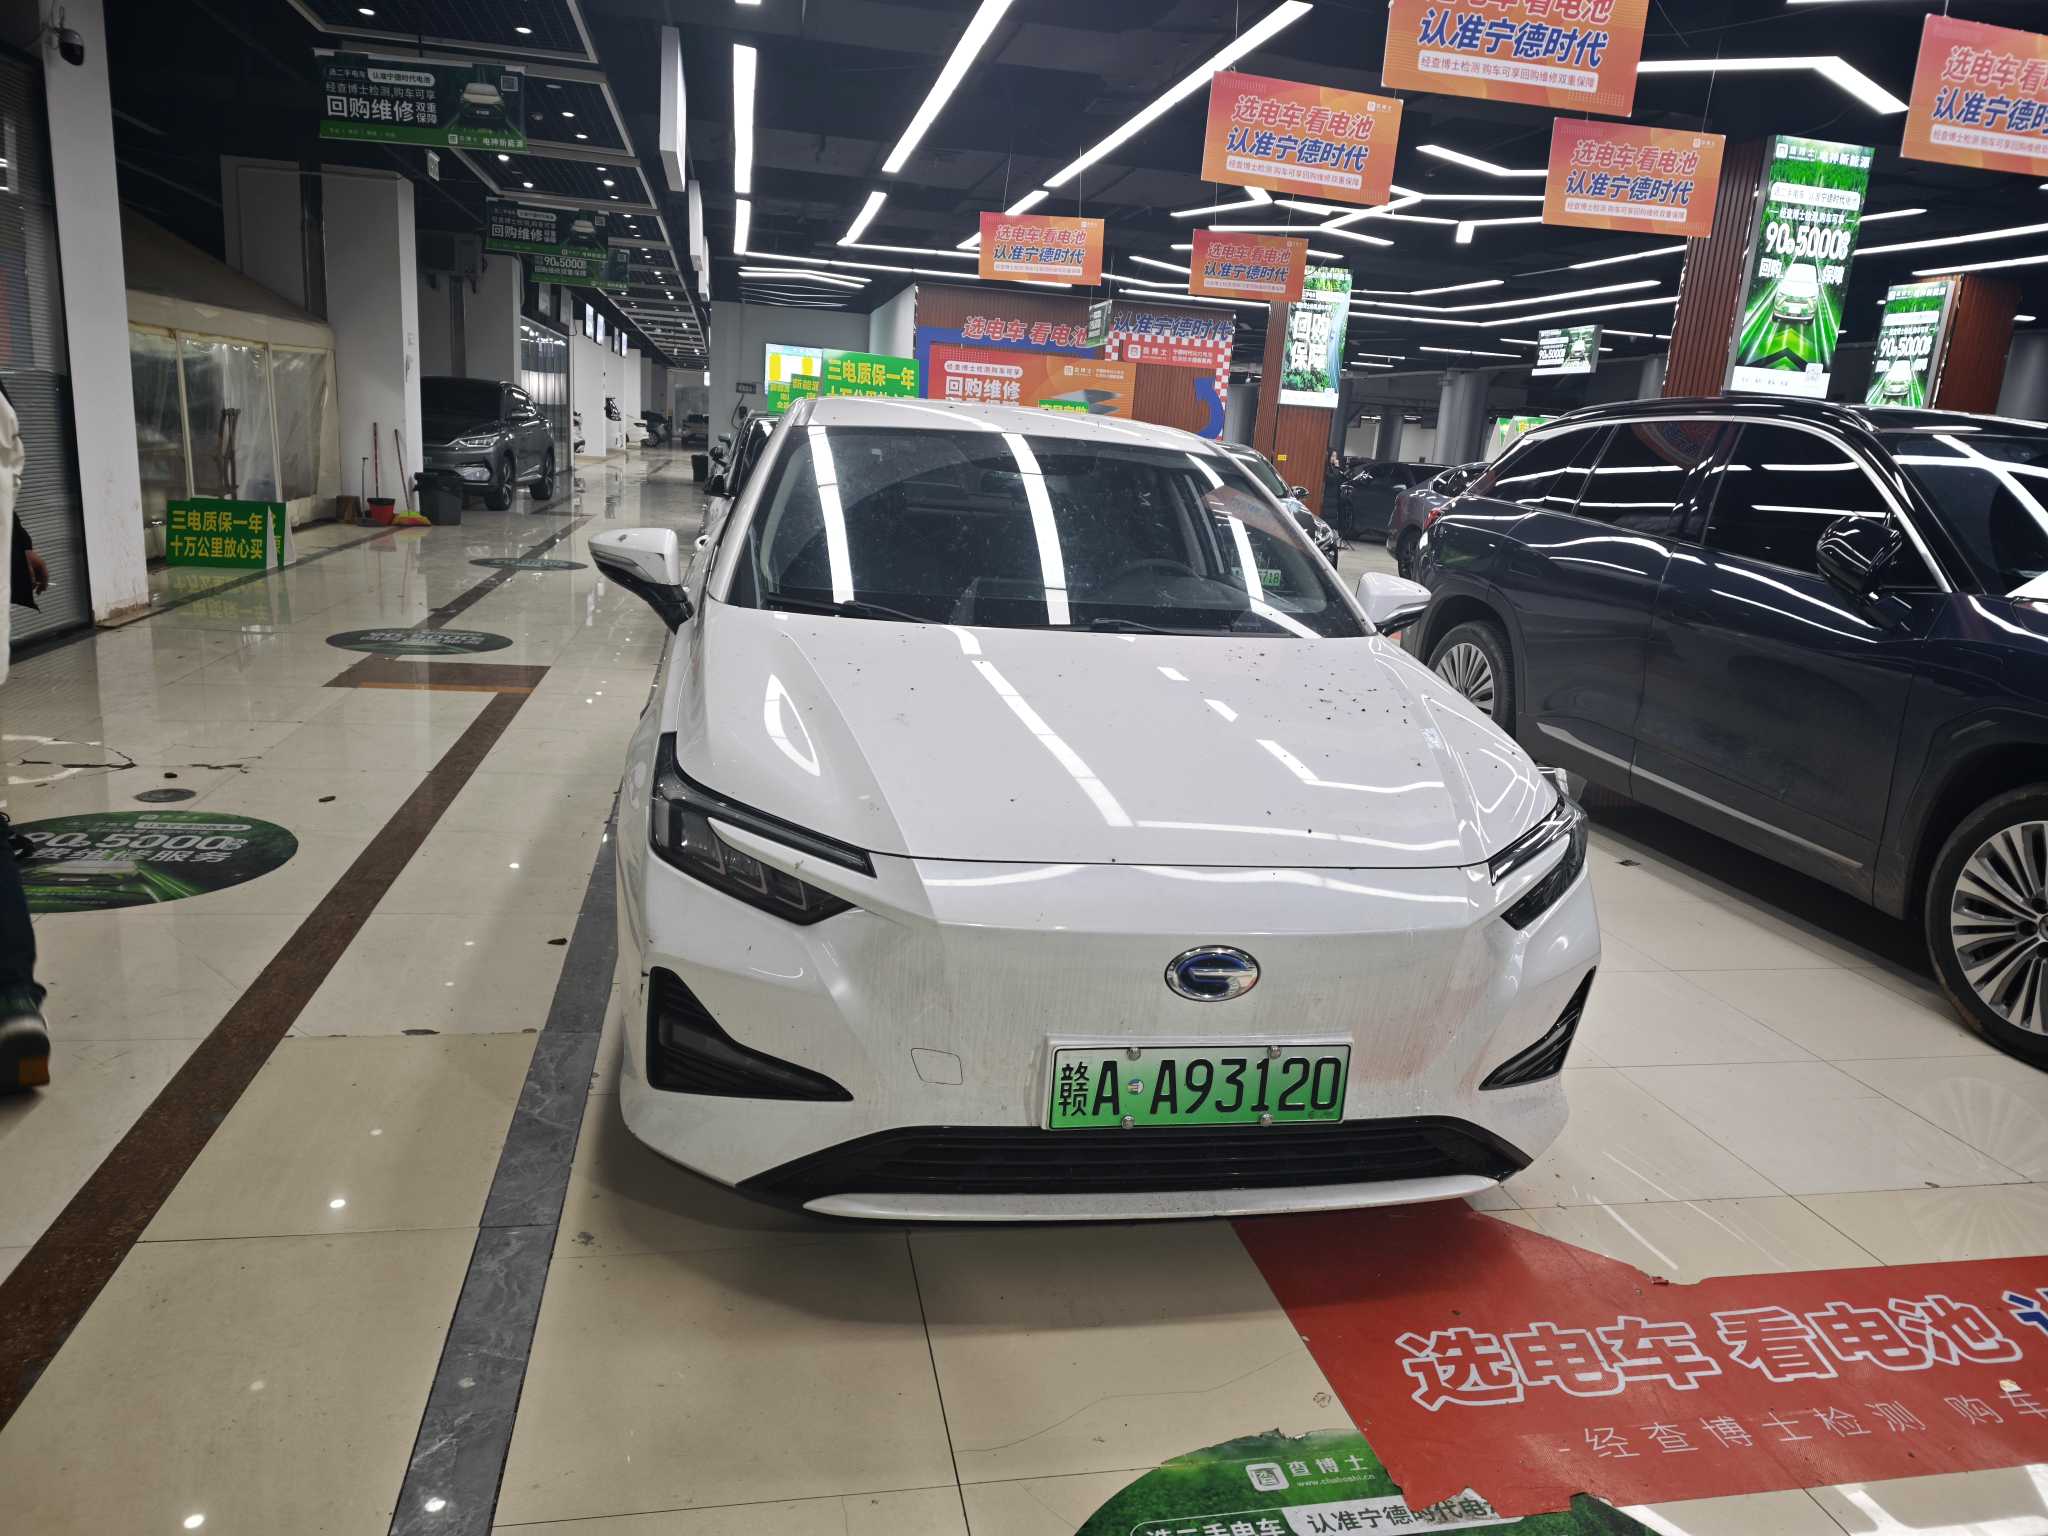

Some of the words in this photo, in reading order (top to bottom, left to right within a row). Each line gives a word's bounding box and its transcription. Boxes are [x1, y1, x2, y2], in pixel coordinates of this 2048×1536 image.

[1417, 8, 1609, 68] 认准宁德时代
[1942, 46, 2048, 95] 选电车看
[327, 95, 414, 122] 回购维修
[1232, 95, 1376, 140] 选电车看电池
[1226, 126, 1369, 173] 认准宁德时代
[1571, 139, 1699, 176] 选电车看电池
[1565, 169, 1693, 206] 认准宁德时代
[993, 224, 1086, 244] 选电车看电池
[992, 244, 1085, 266] 认准宁德时代
[1206, 241, 1291, 264] 选电车看电池
[1203, 261, 1288, 282] 认准宁德时代
[961, 315, 1088, 348] 选电车看电池
[1112, 311, 1235, 342] 认准宁德时代
[827, 357, 915, 391] 三电质保一年
[944, 376, 1021, 400] 回购维修
[171, 509, 263, 534] 三电质保一年
[170, 534, 263, 561] 十万公里放心买
[1149, 1056, 1342, 1115] A93120
[1395, 1294, 2022, 1412] 选电车看电池
[1286, 1453, 1370, 1479] 查博士
[1306, 1497, 1494, 1535] 认准宁德时代电
